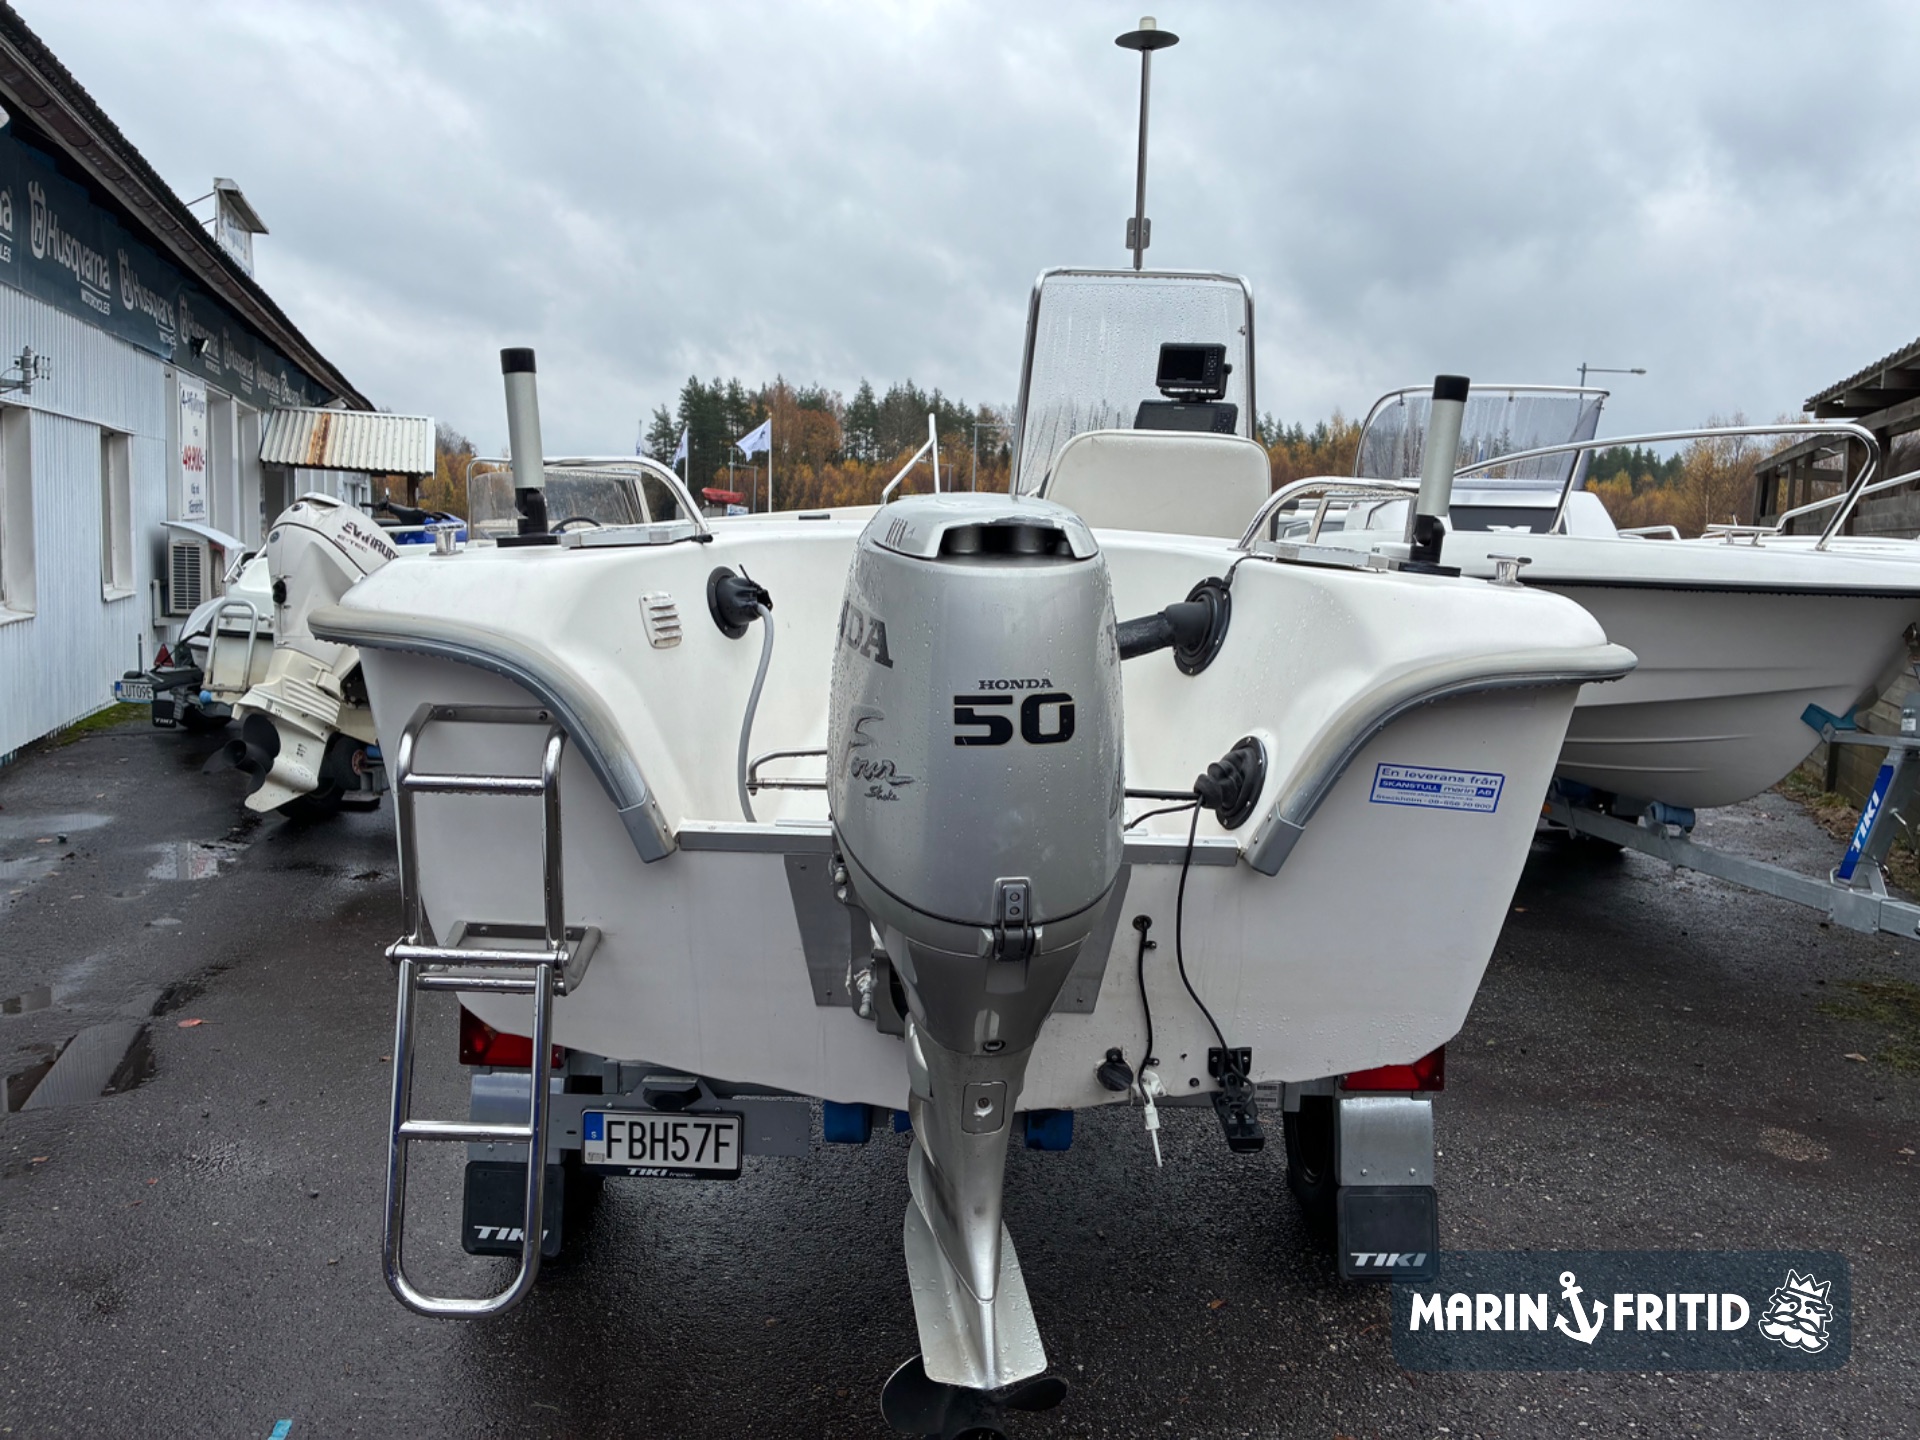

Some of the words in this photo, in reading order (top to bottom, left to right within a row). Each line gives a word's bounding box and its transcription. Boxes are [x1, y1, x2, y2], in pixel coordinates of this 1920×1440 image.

[47, 209, 111, 291] Husqvarna
[978, 678, 1054, 690] HONDA
[954, 692, 1075, 746] 50
[1381, 767, 1400, 778] En
[1404, 770, 1465, 783] leverans
[1470, 775, 1498, 786] från
[1381, 780, 1439, 792] SKANSTULL
[1443, 786, 1475, 795] marin
[1477, 789, 1492, 797] AB
[1850, 790, 1880, 853] TIKI
[606, 1120, 733, 1163] FBH57F
[627, 1167, 668, 1177] TIKI
[1350, 1252, 1427, 1268] TIKI
